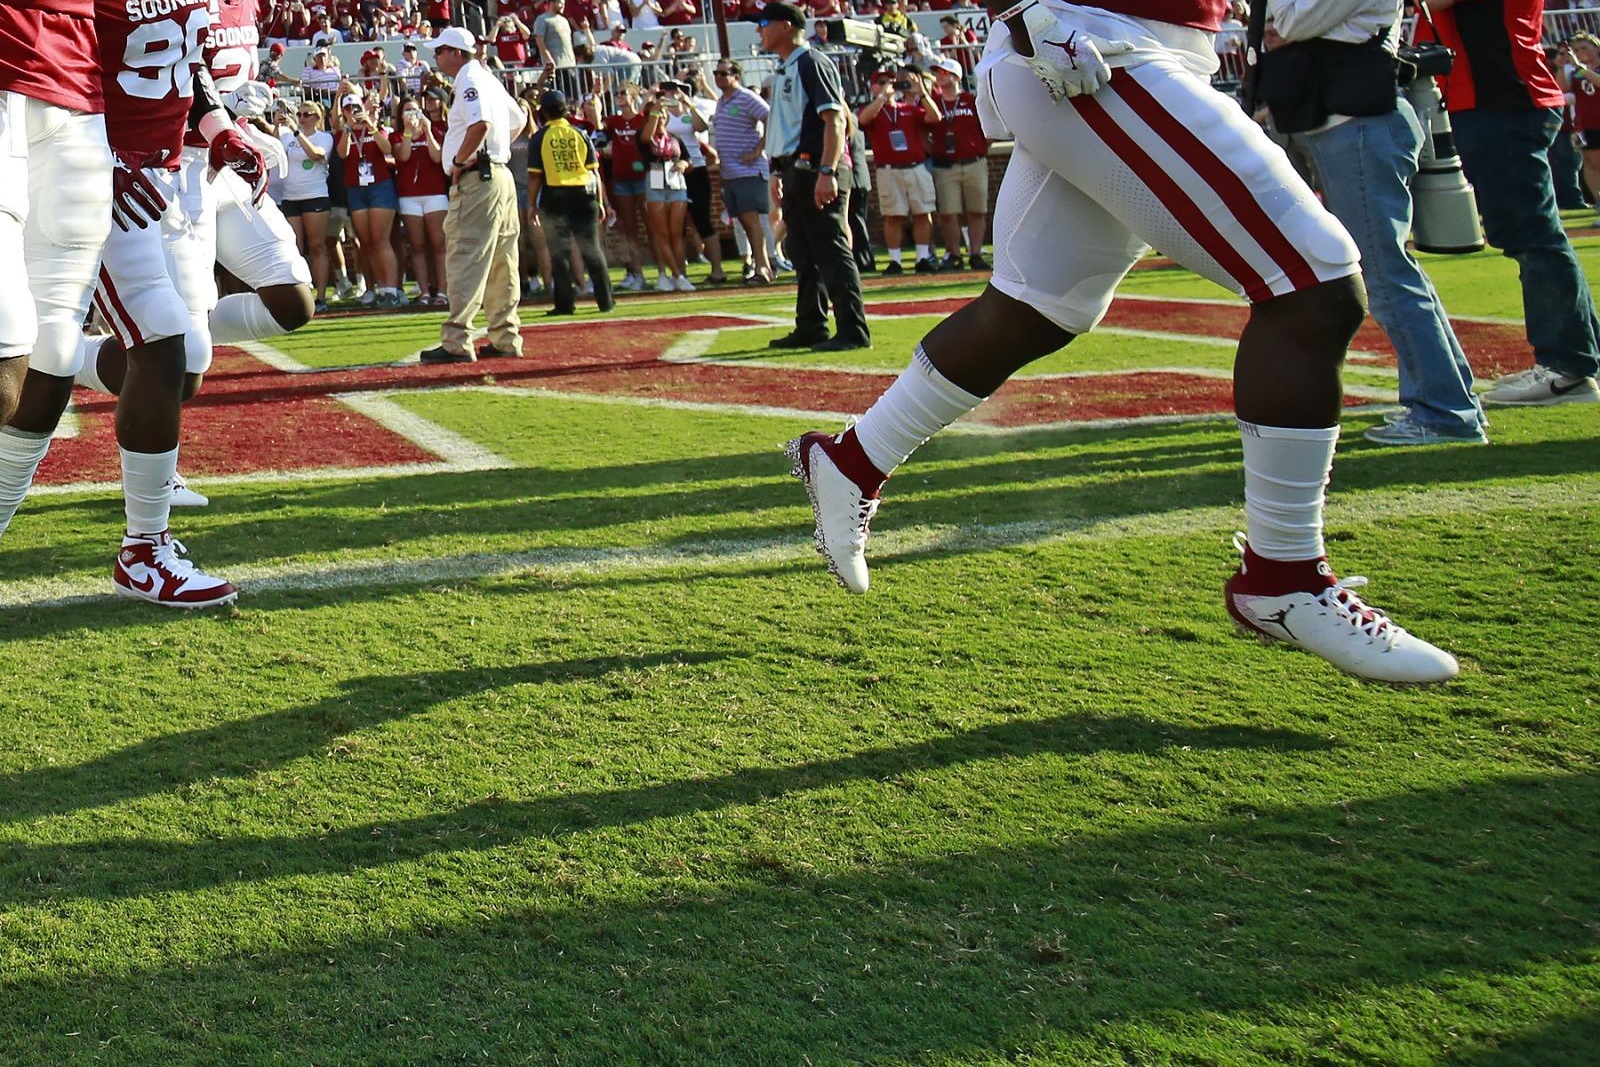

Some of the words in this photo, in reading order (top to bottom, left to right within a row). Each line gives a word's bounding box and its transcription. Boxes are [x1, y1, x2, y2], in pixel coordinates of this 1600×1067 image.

[551, 138, 577, 149] CSC
[553, 150, 579, 161] EVENT
[555, 161, 581, 172] STAFF
